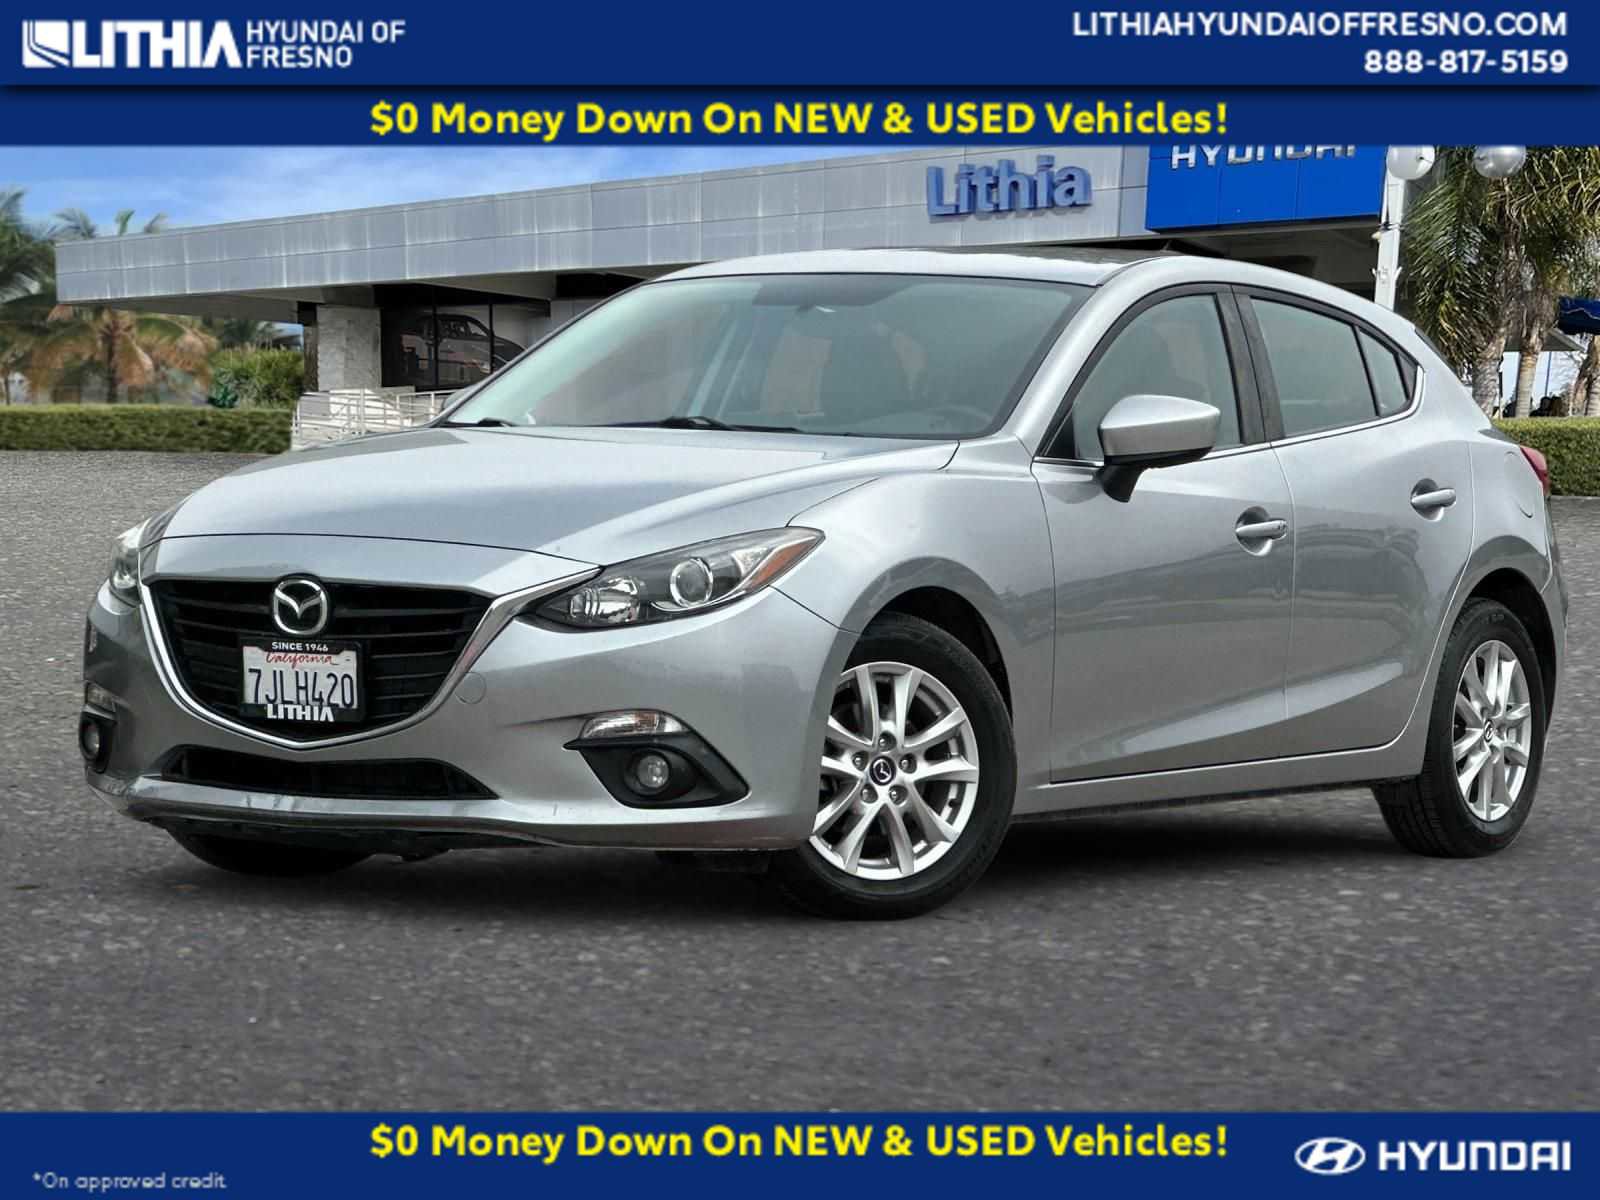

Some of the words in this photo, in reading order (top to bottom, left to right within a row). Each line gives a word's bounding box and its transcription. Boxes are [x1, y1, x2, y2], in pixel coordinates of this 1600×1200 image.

[925, 154, 1093, 219] Lithia
[271, 641, 303, 651] SINCE
[305, 642, 329, 652] 1946
[266, 652, 338, 668] California
[248, 668, 354, 708] 7JLH420
[266, 703, 335, 722] LITHIA
